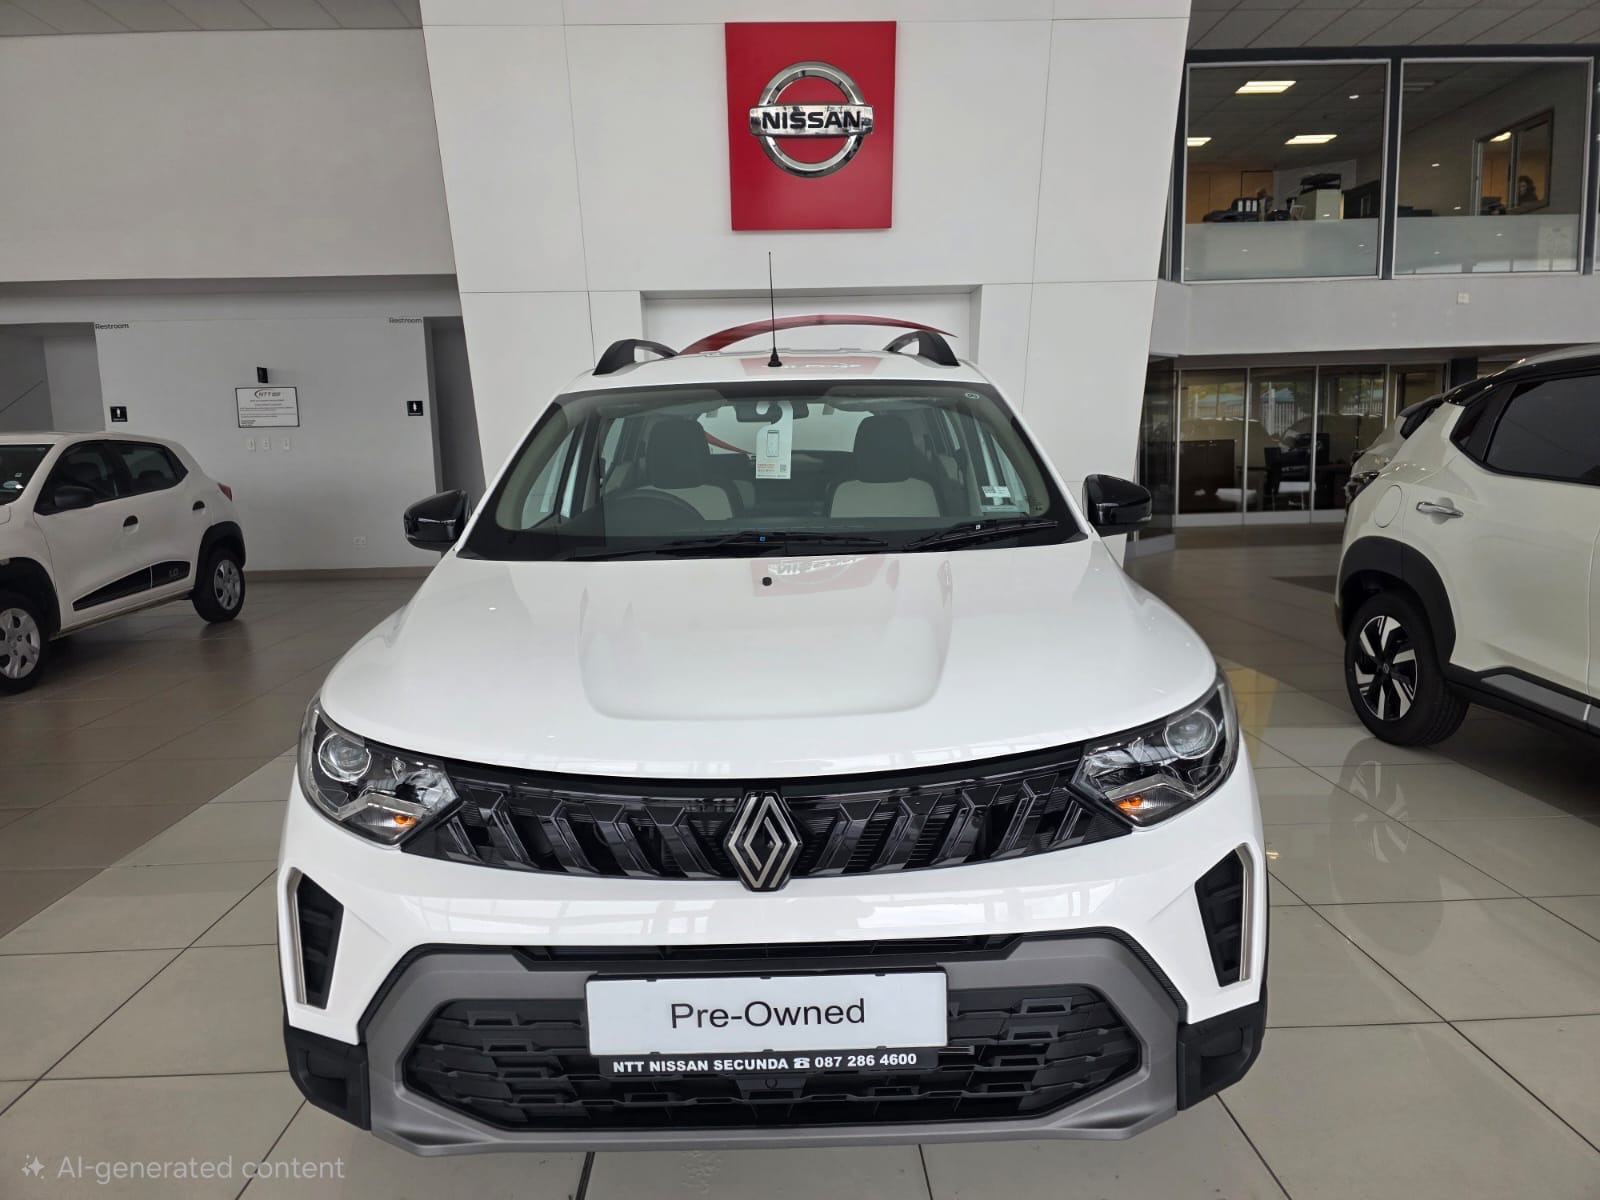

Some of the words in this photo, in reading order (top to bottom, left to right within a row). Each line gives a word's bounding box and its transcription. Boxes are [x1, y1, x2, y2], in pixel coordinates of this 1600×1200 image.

[762, 111, 861, 129] NISSAN
[95, 322, 129, 330] Restroom
[670, 998, 865, 1029] Pre-Owned
[613, 1061, 645, 1073] NTT
[650, 1060, 709, 1072] NISSAN
[713, 1058, 789, 1071] SECUNDA
[814, 1056, 843, 1068] 087
[847, 1055, 875, 1067] 286
[879, 1053, 917, 1066] 4600
